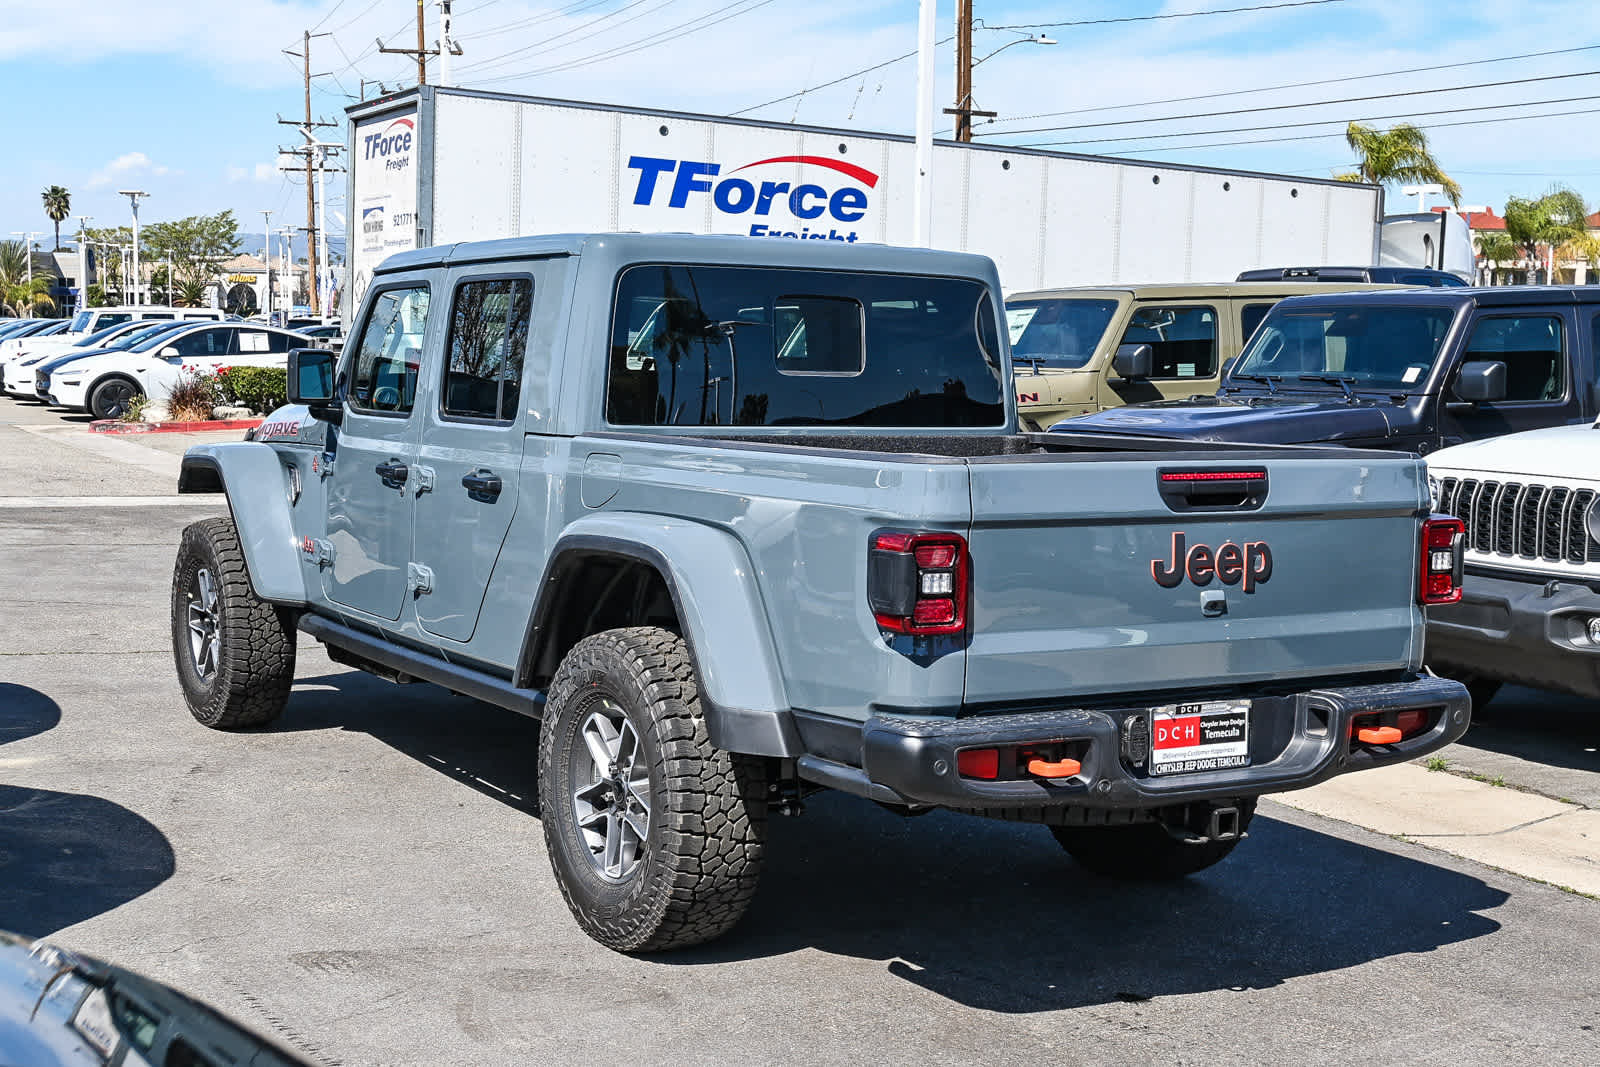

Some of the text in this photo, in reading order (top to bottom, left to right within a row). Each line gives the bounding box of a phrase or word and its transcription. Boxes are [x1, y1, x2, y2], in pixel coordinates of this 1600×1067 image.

[365, 132, 411, 160] TForce
[386, 157, 409, 171] Freight
[627, 155, 868, 223] TForce
[393, 213, 412, 227] 921771
[227, 273, 257, 284] MIDAS
[256, 421, 299, 438] MOJAVE
[1150, 531, 1273, 594] Jeep
[1200, 720, 1219, 728] Chrysler
[1219, 720, 1230, 728] Jeep
[1205, 727, 1240, 739] Temecula
[1156, 755, 1246, 773] CHRYSLER JEEP DODGE TEMECULA
